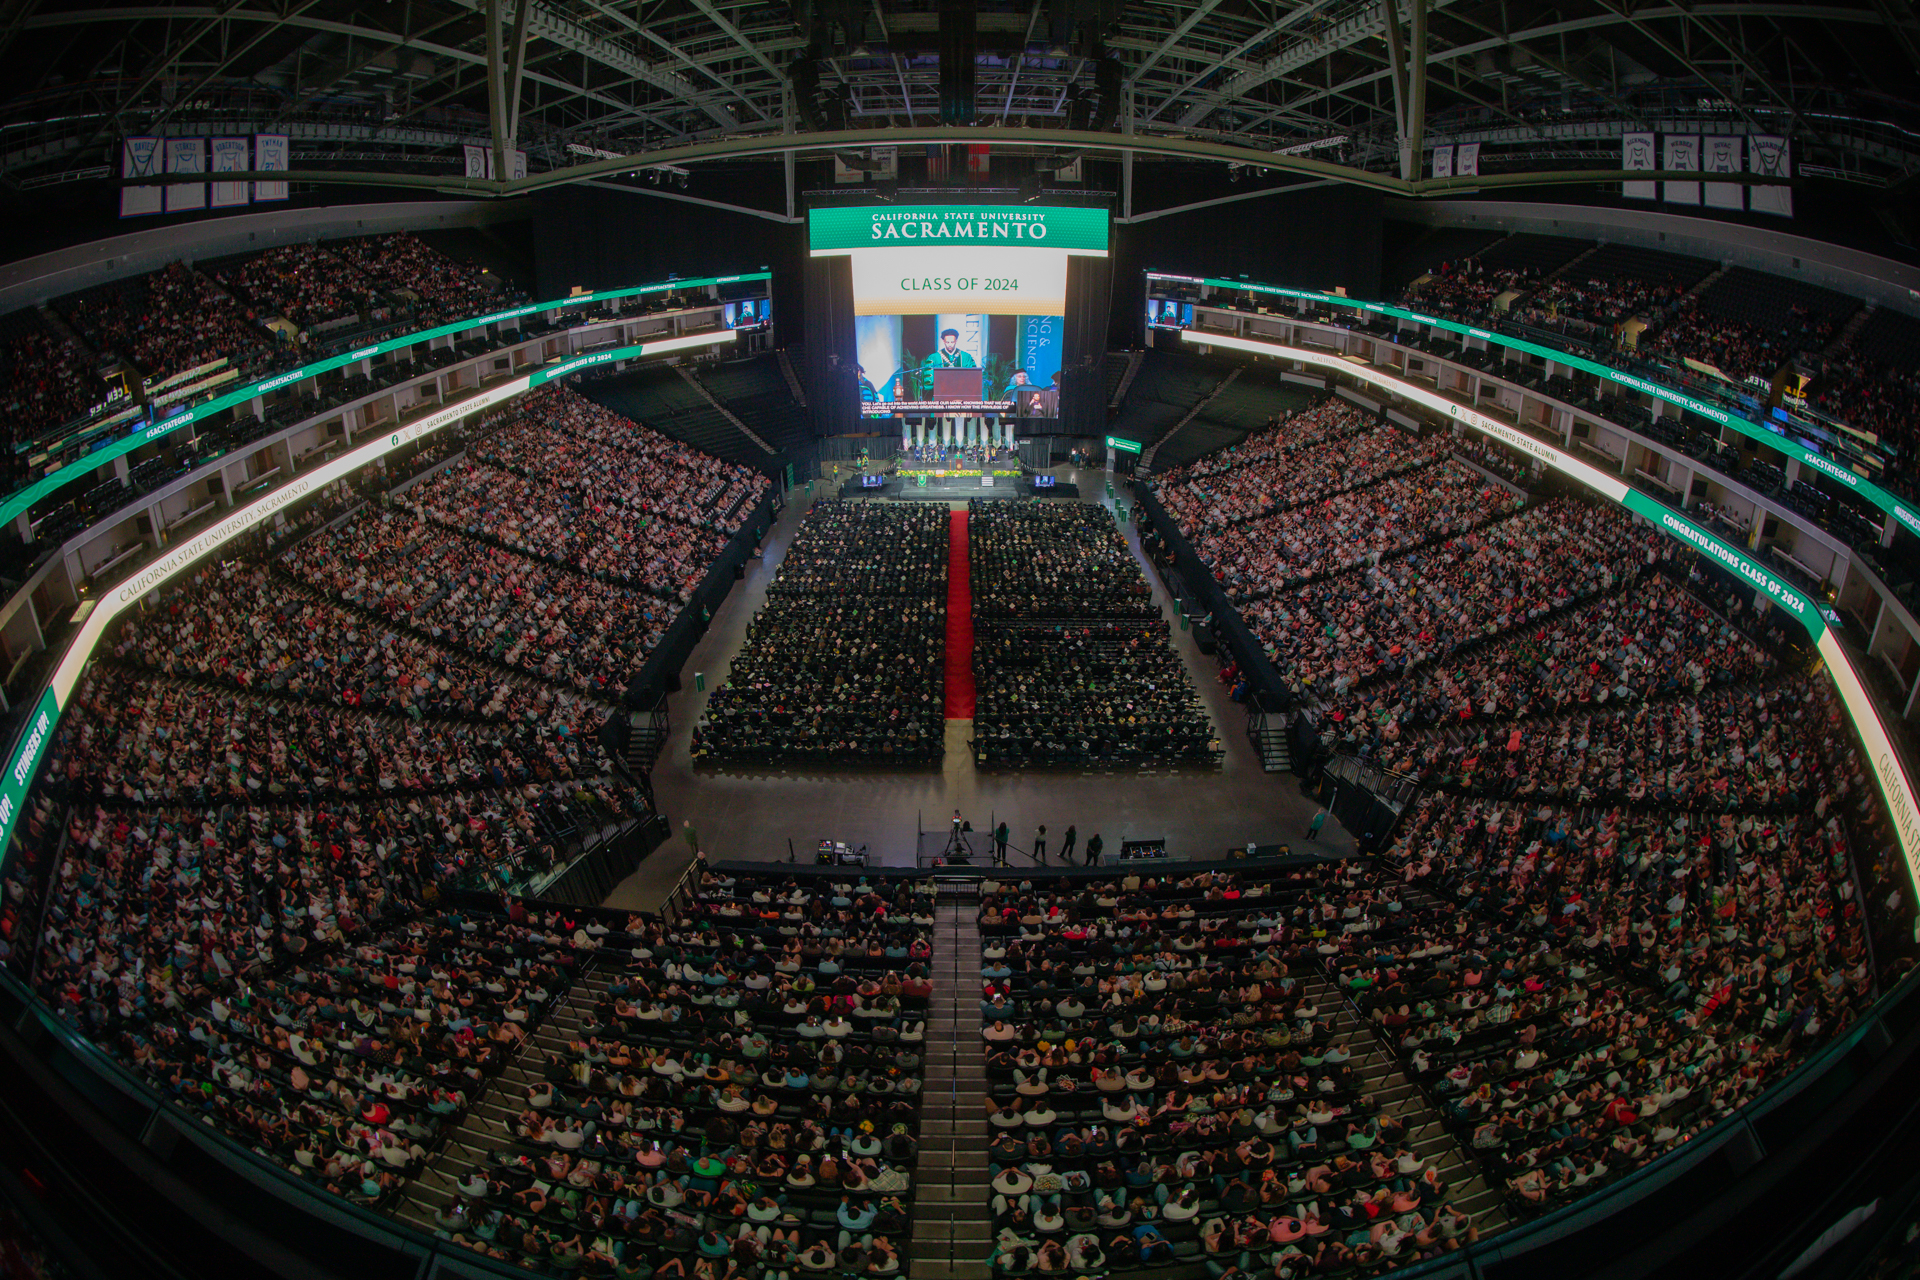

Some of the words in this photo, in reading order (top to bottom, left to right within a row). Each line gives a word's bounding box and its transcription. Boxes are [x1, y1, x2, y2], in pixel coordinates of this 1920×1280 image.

[1750, 141, 1788, 157] SOJAKOVC
[871, 221, 1047, 239] SACRAMENTO
[872, 213, 938, 221] CALIFORNIA
[981, 213, 1046, 221] UNIVERSITY
[900, 278, 952, 291] CLASS
[957, 278, 978, 291] OF
[984, 278, 1019, 291] 2024
[1240, 283, 1264, 291] CALIFORNIA
[588, 356, 596, 364] OF
[597, 353, 612, 362] 2024
[1027, 318, 1038, 371] SCIENCE
[257, 370, 304, 392] #MADEATSACSTATE
[1610, 371, 1641, 389] CALIFORNIA
[1641, 382, 1656, 394] STATE
[1656, 388, 1689, 407] UNIVERSITY,
[1689, 400, 1728, 423] SACRAMENTO
[146, 412, 194, 439] #SACSTATEGRAD
[426, 410, 459, 429] SACRAMENTO
[459, 403, 473, 415] STATE
[473, 396, 491, 409] ALUMNI
[1481, 420, 1516, 442] SACRAMENTO
[1516, 437, 1533, 451] STATE
[1534, 445, 1557, 463] ALUMNI
[1804, 452, 1857, 486] #SACSTATEGRAD
[119, 560, 178, 603] CALIFORNIA
[178, 543, 205, 565] STATE
[204, 511, 257, 548] UNIVERSITY,
[256, 480, 309, 517] SACRAMENTO
[1662, 513, 1740, 569] CONGRATULATIONS
[1740, 561, 1767, 588] CLASS
[1768, 580, 1781, 596] OF
[1782, 589, 1806, 614] 2024
[13, 726, 43, 787] STINGERS
[36, 710, 50, 731] UP!
[0, 793, 14, 825] UP!
[1878, 752, 1914, 838] CALIFORNIA
